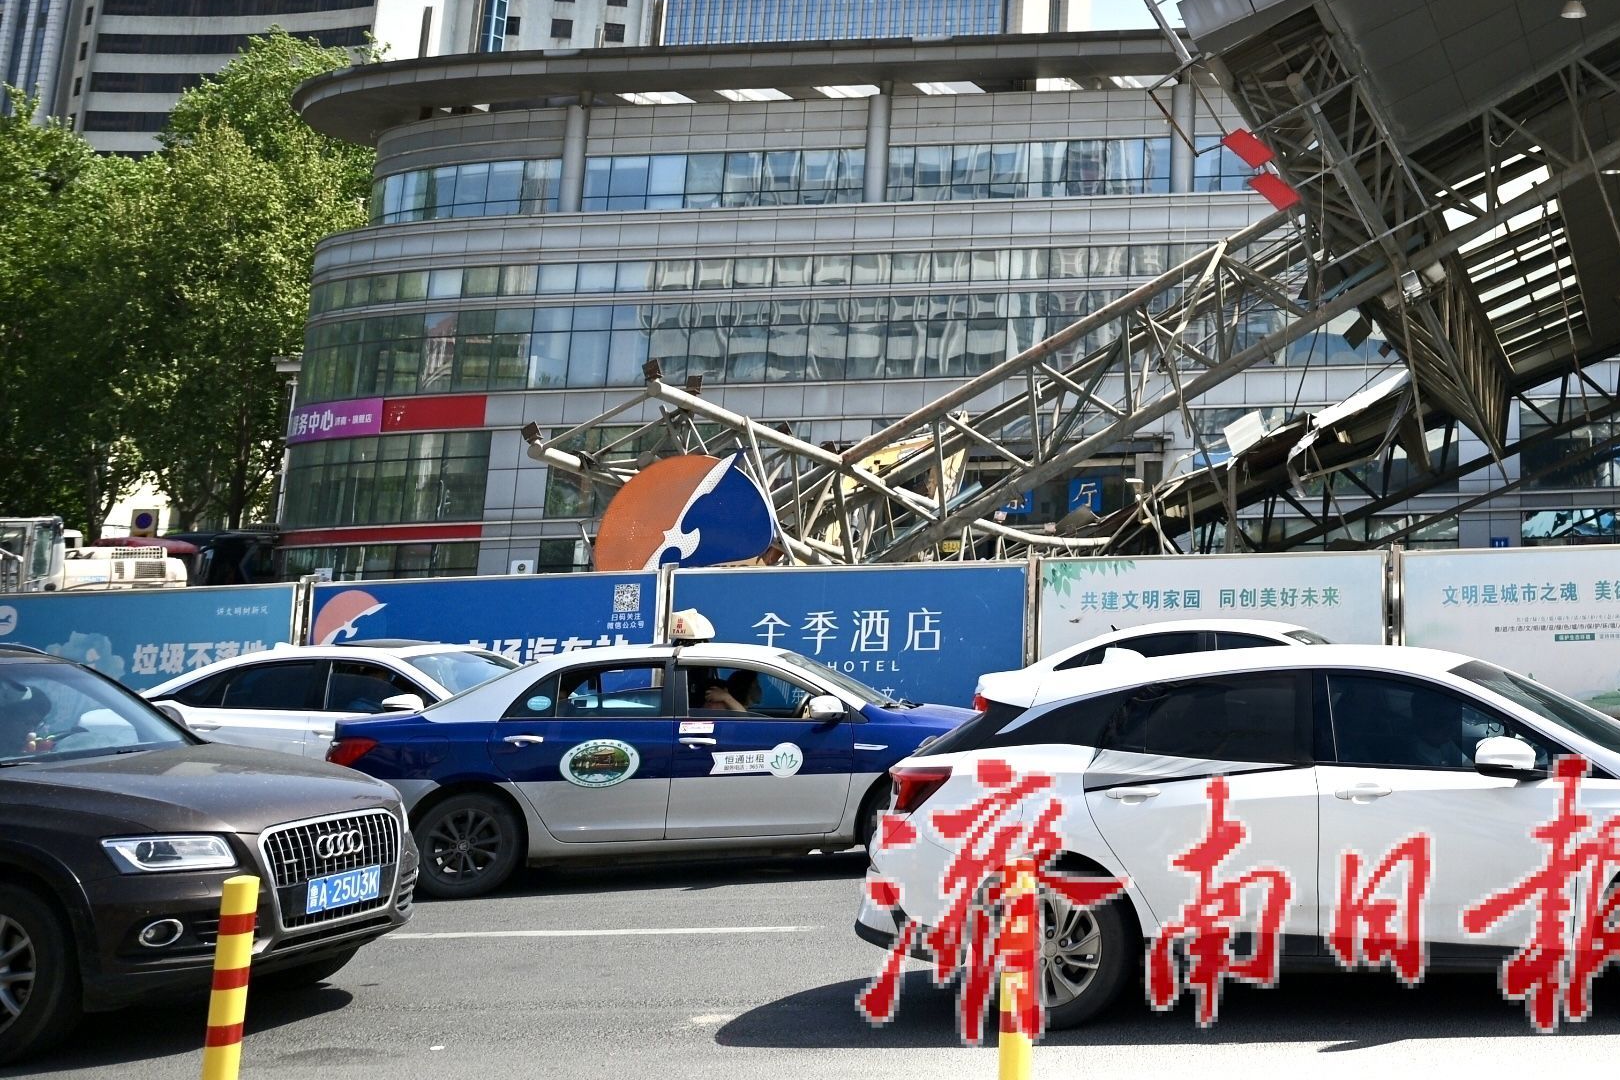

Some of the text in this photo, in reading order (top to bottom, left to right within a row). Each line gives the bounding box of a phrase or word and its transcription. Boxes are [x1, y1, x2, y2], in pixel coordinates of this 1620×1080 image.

[1080, 586, 1341, 610] 共建文明家园 同创美好未来
[1441, 581, 1579, 606] 文明是城市之魂
[606, 620, 645, 630] 微信公众号
[611, 613, 642, 621] 扫码关注
[751, 606, 944, 656] 全季酒店
